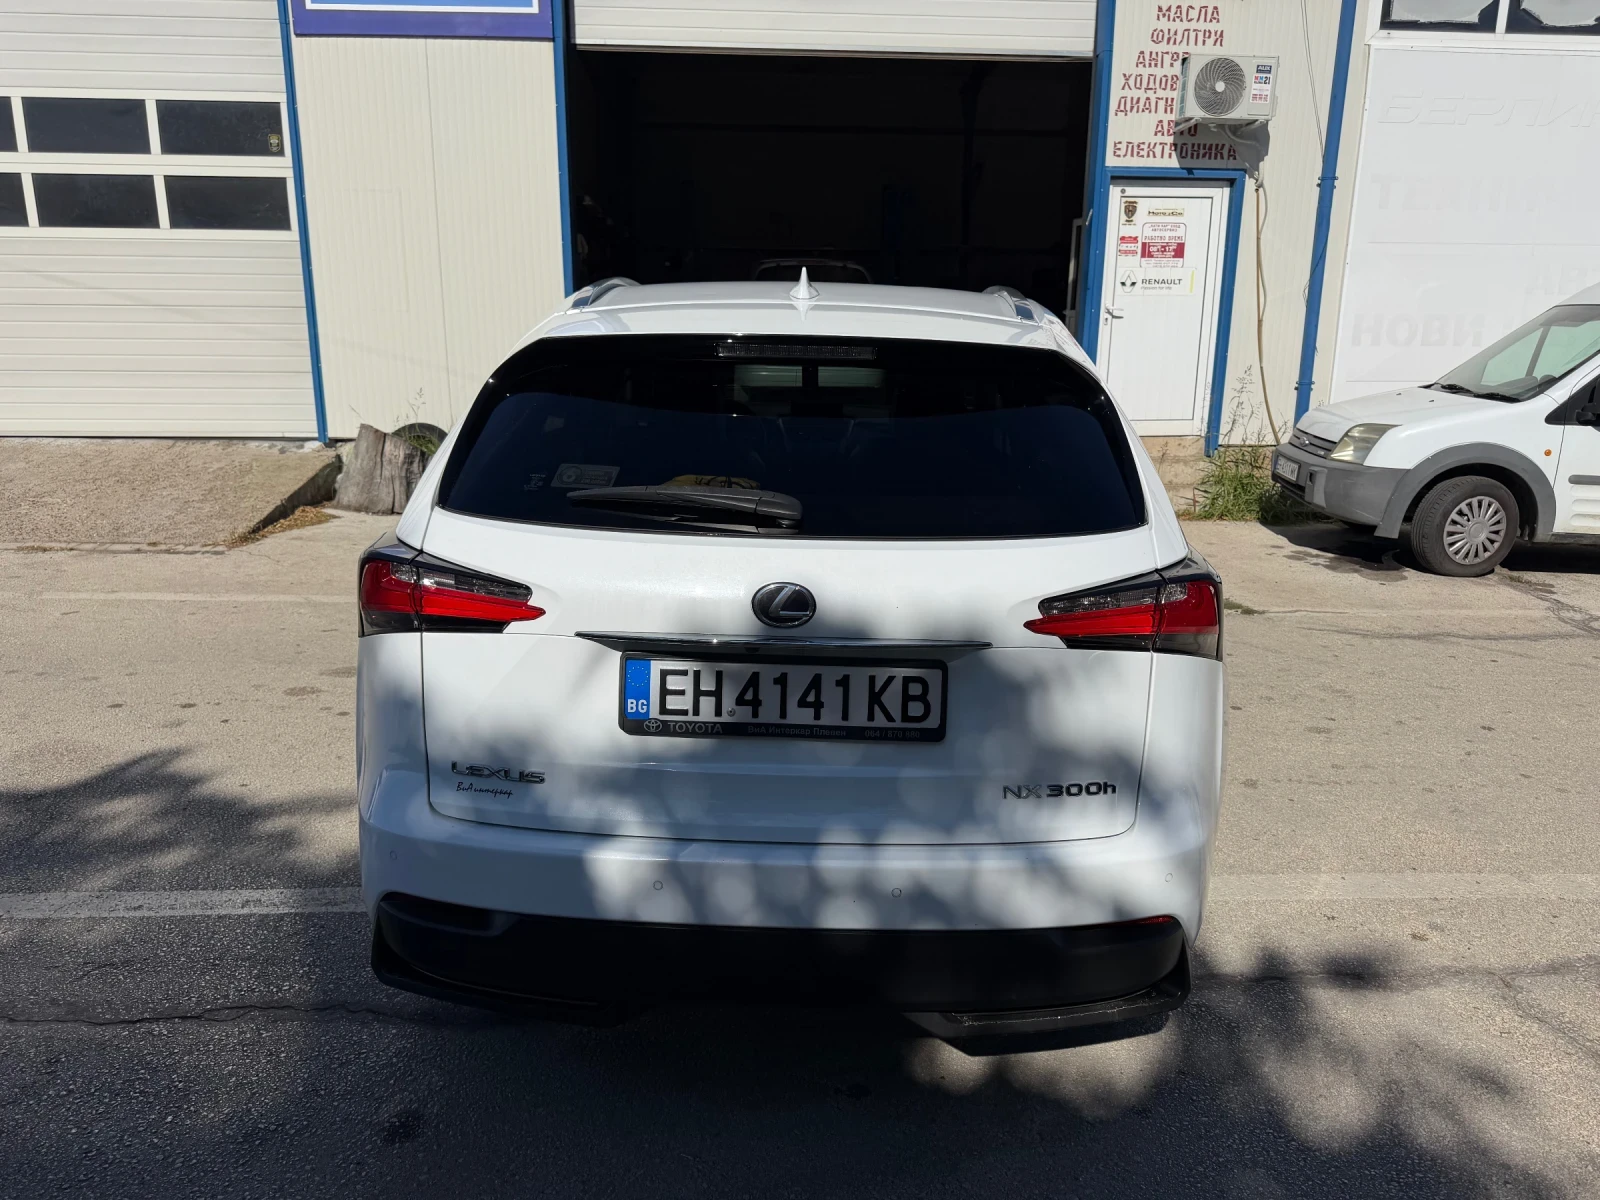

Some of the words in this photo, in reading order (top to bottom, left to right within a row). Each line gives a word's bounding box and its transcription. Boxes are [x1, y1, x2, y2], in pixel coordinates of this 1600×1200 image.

[1156, 5, 1221, 23] МАСЛА
[1151, 28, 1224, 47] ФИЛТРИ
[1121, 73, 1179, 94] ХОДОВ
[1114, 96, 1175, 116] ДИАГН
[1153, 119, 1198, 137] АВО
[1112, 140, 1238, 160] ЕЛЕКТРОНИКА
[627, 698, 648, 714] BG
[667, 722, 723, 734] TOYOTA
[451, 761, 546, 784] LEXUS
[1003, 784, 1042, 799] NX
[1046, 781, 1117, 798] 300h
